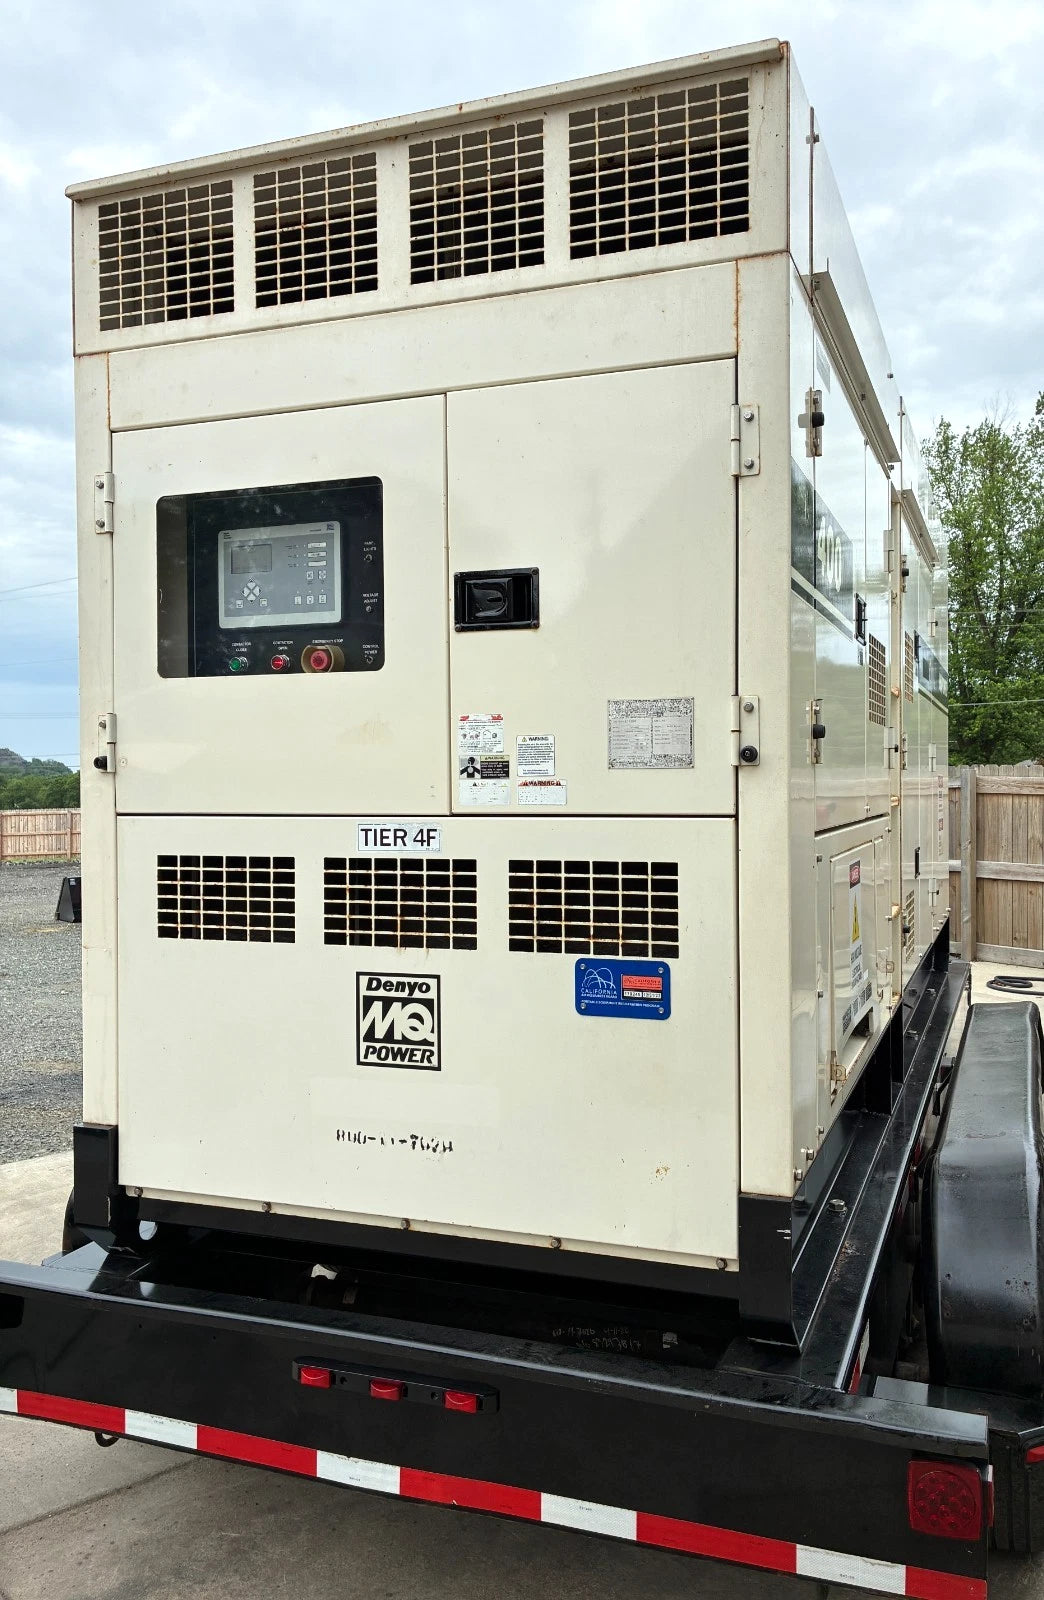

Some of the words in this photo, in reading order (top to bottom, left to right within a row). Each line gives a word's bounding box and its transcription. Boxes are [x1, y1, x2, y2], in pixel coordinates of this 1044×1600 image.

[360, 828, 408, 847] TIER
[412, 828, 437, 847] 4F
[365, 976, 431, 997] Denyo
[580, 987, 618, 996] CALIFORNIA
[361, 1000, 434, 1043] MQ
[363, 1044, 435, 1065] POWER
